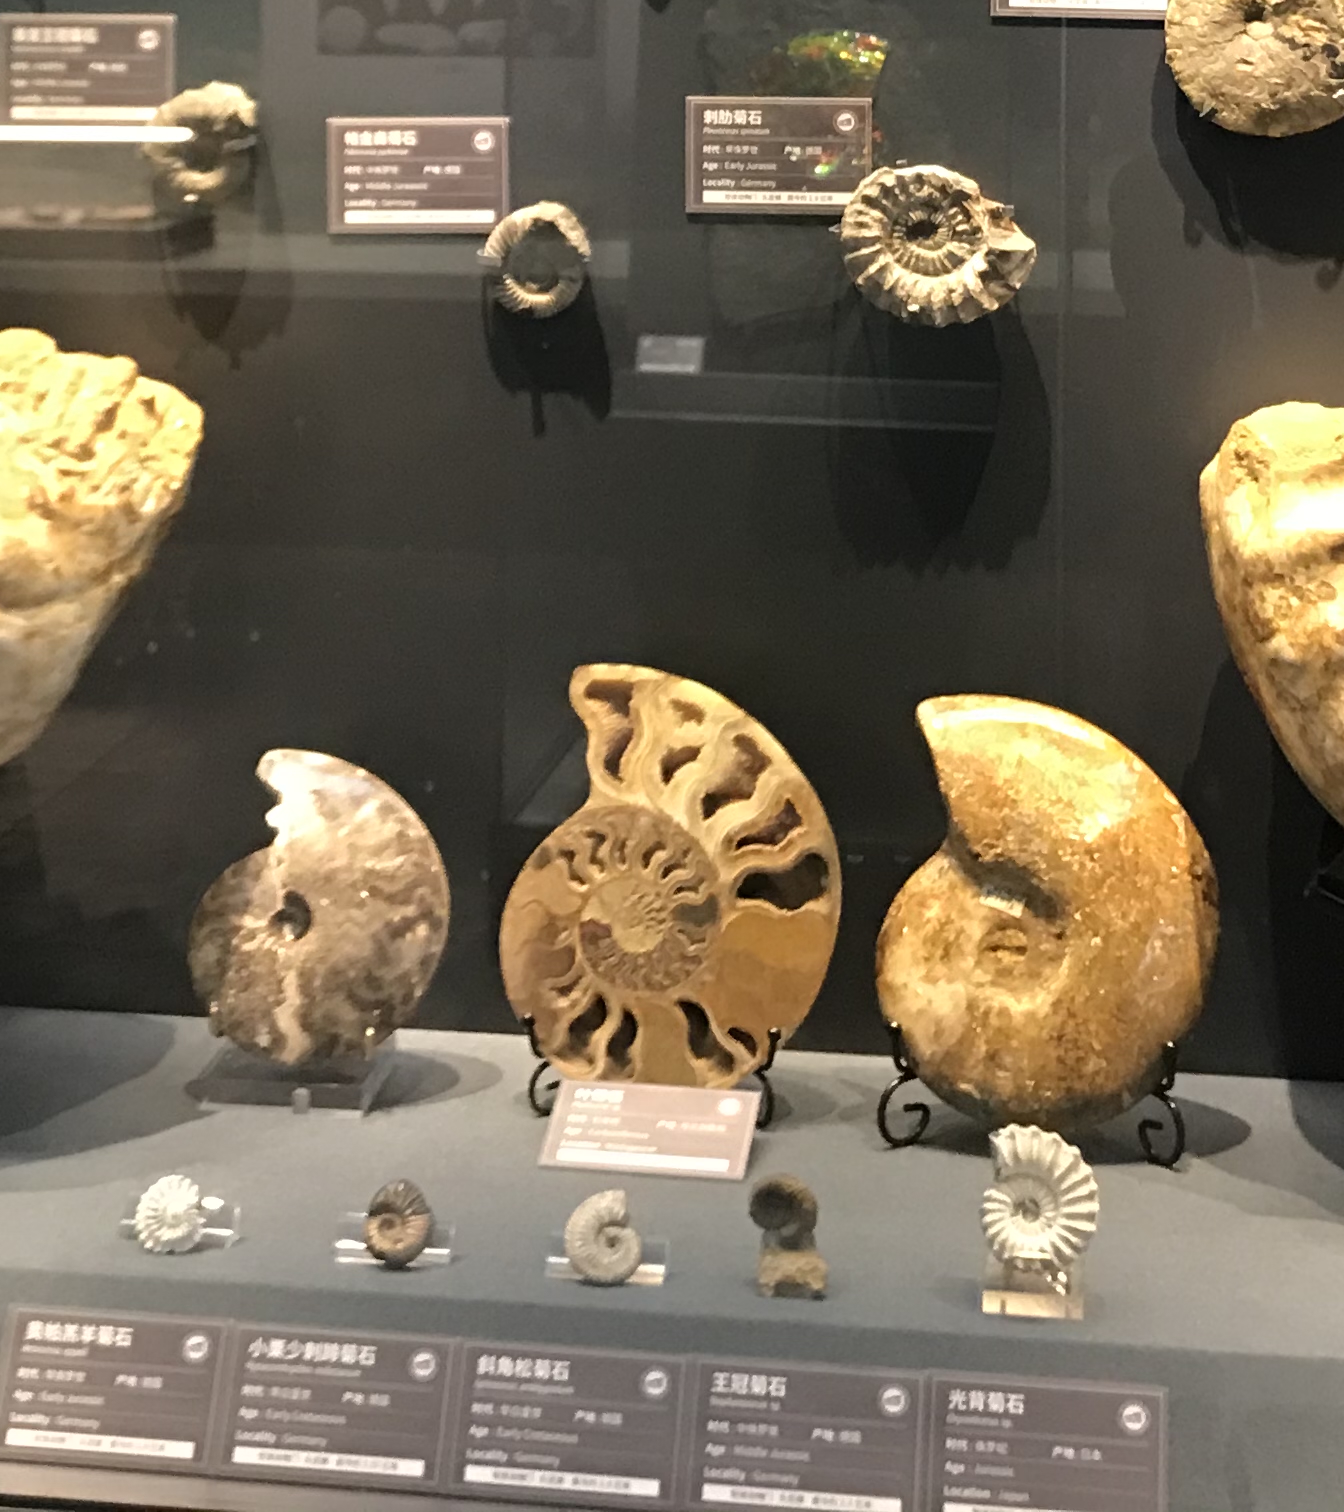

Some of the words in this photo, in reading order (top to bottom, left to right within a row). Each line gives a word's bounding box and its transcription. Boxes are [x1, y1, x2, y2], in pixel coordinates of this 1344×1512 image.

[703, 110, 762, 125] 刺肋菊石
[703, 145, 720, 154] 时代
[703, 162, 718, 171] Age
[725, 162, 744, 171] Early
[703, 179, 735, 188] Locality
[741, 179, 776, 188] Germany
[345, 200, 376, 208] Locality
